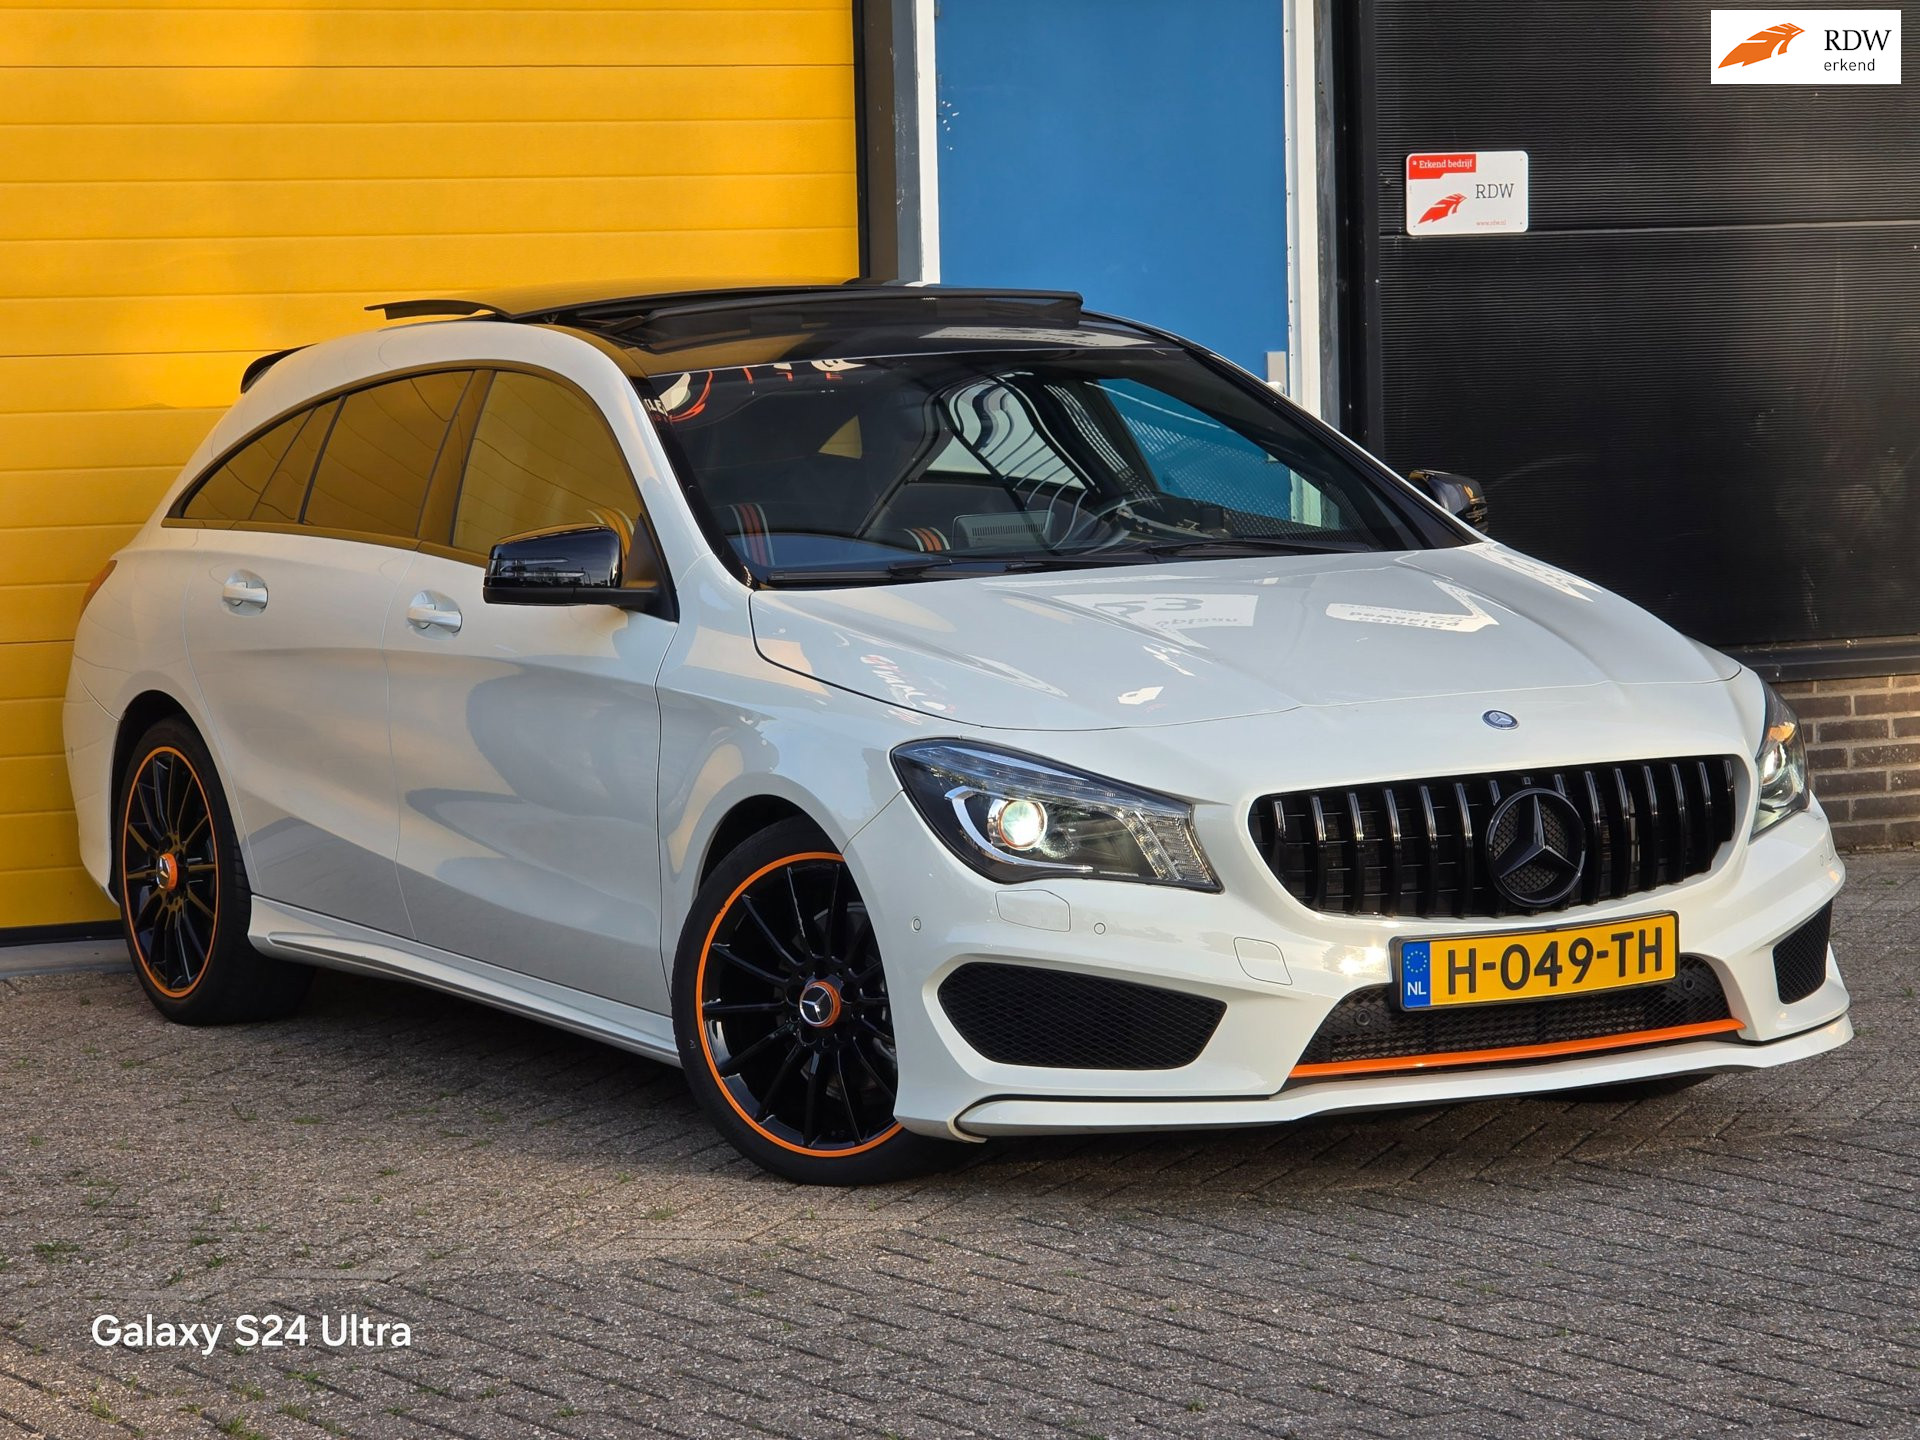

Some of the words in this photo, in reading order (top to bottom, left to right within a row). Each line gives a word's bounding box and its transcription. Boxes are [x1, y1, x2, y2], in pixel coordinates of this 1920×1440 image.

[1419, 160, 1446, 169] Erkend
[1448, 158, 1472, 168] bedrijf
[1475, 183, 1514, 199] RDW
[1448, 926, 1663, 995] H-049-TH
[1407, 981, 1427, 996] NL
